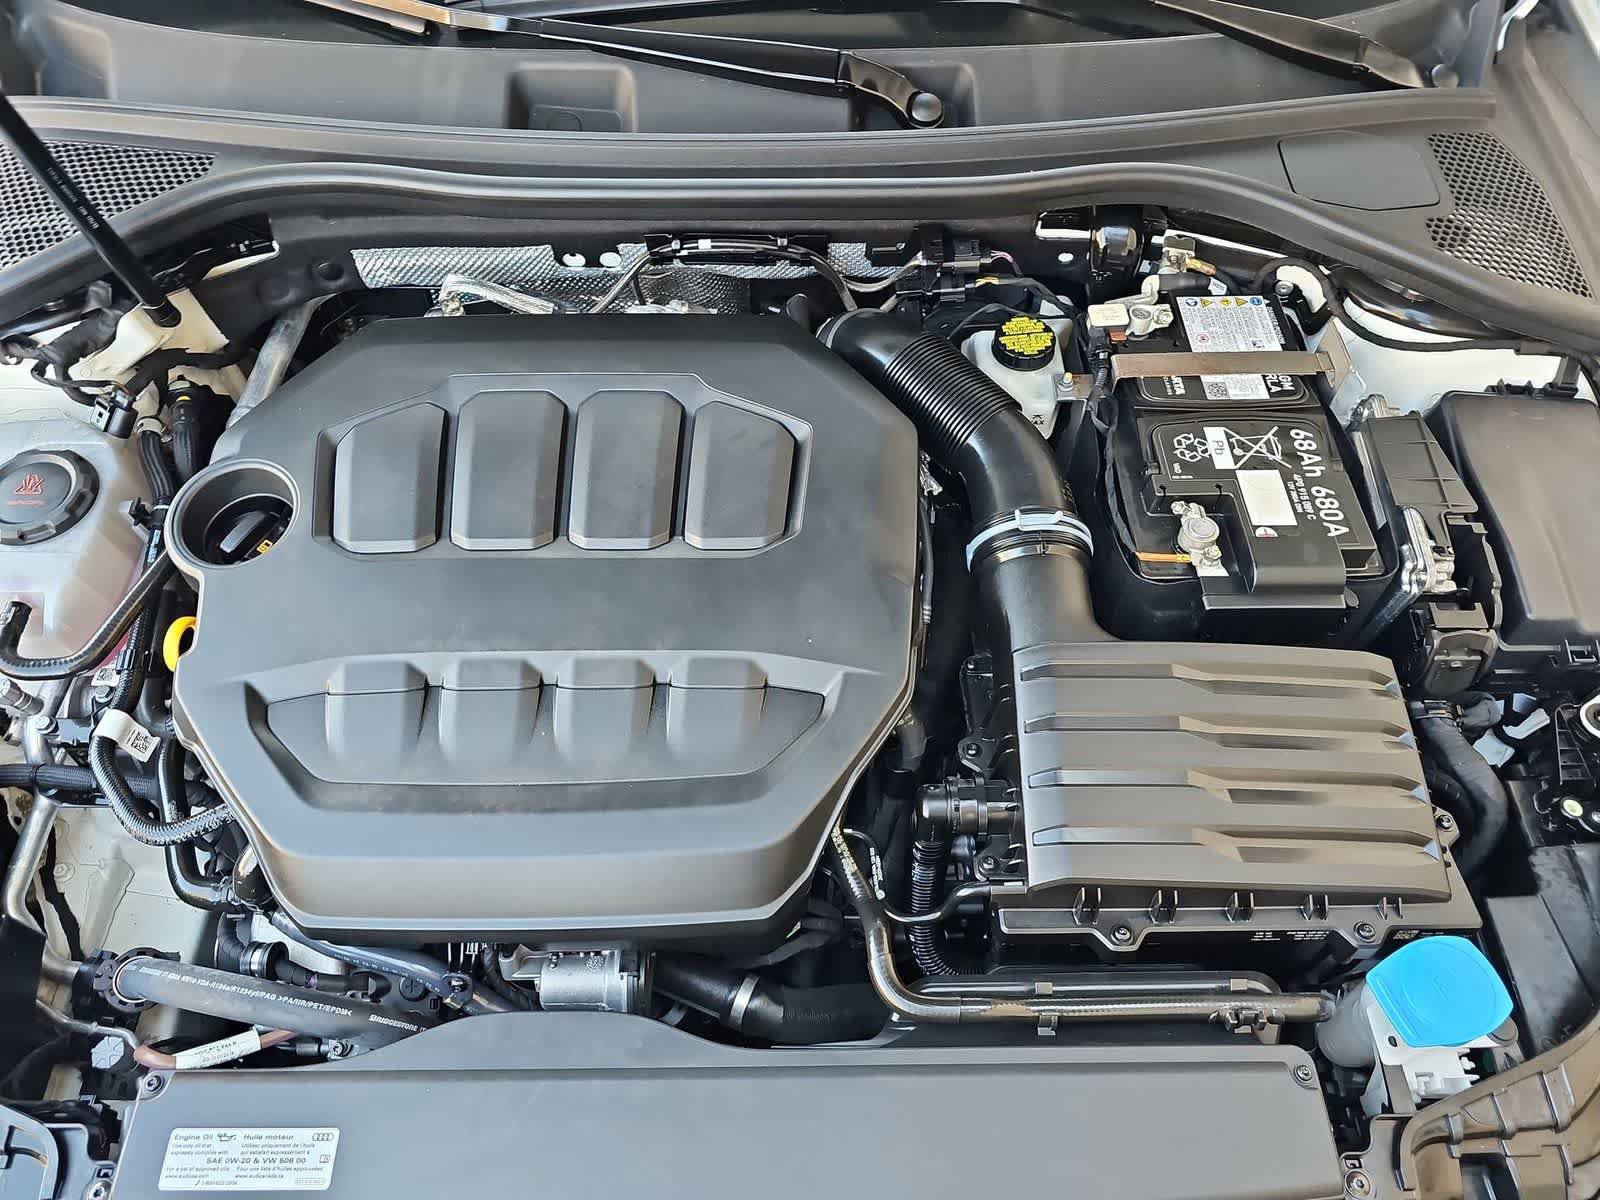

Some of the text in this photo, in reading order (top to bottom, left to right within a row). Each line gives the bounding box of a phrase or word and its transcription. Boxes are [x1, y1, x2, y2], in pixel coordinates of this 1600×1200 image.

[1278, 374, 1296, 391] GM
[1289, 428, 1350, 537] 68Ah 680A
[174, 1134, 201, 1142] Engine
